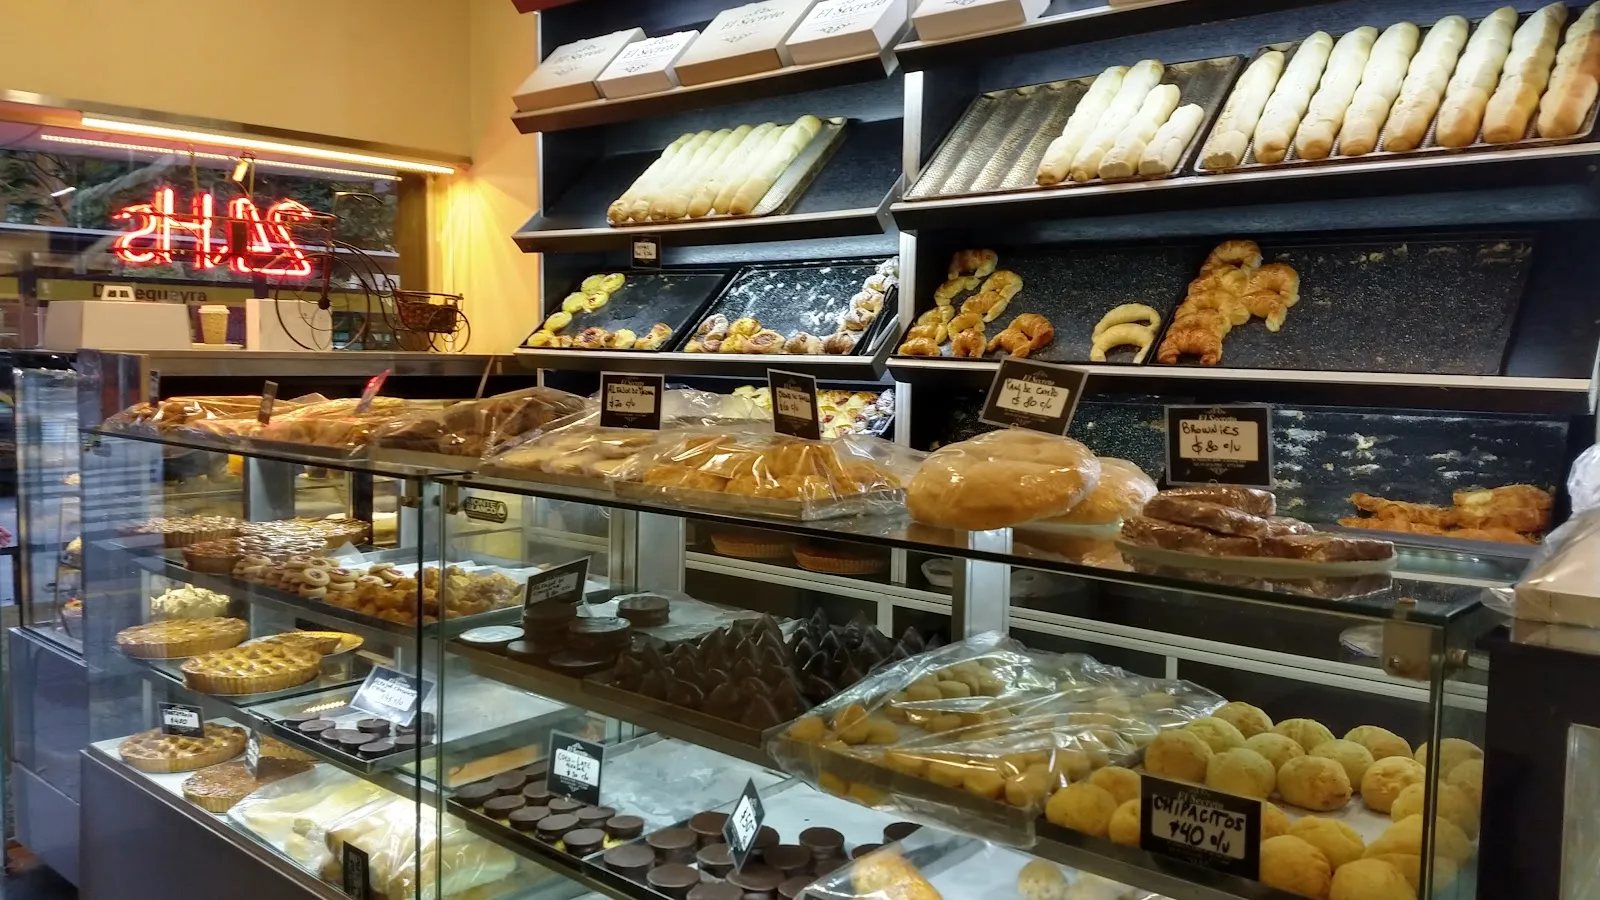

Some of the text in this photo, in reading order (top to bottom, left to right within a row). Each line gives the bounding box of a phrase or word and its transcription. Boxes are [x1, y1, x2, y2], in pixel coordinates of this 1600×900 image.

[721, 11, 785, 30] El Secreto
[816, 8, 833, 18] El
[624, 43, 680, 58] El Secreto
[93, 283, 207, 303] Degueyra
[1153, 796, 1245, 832] CHIPACITOS
